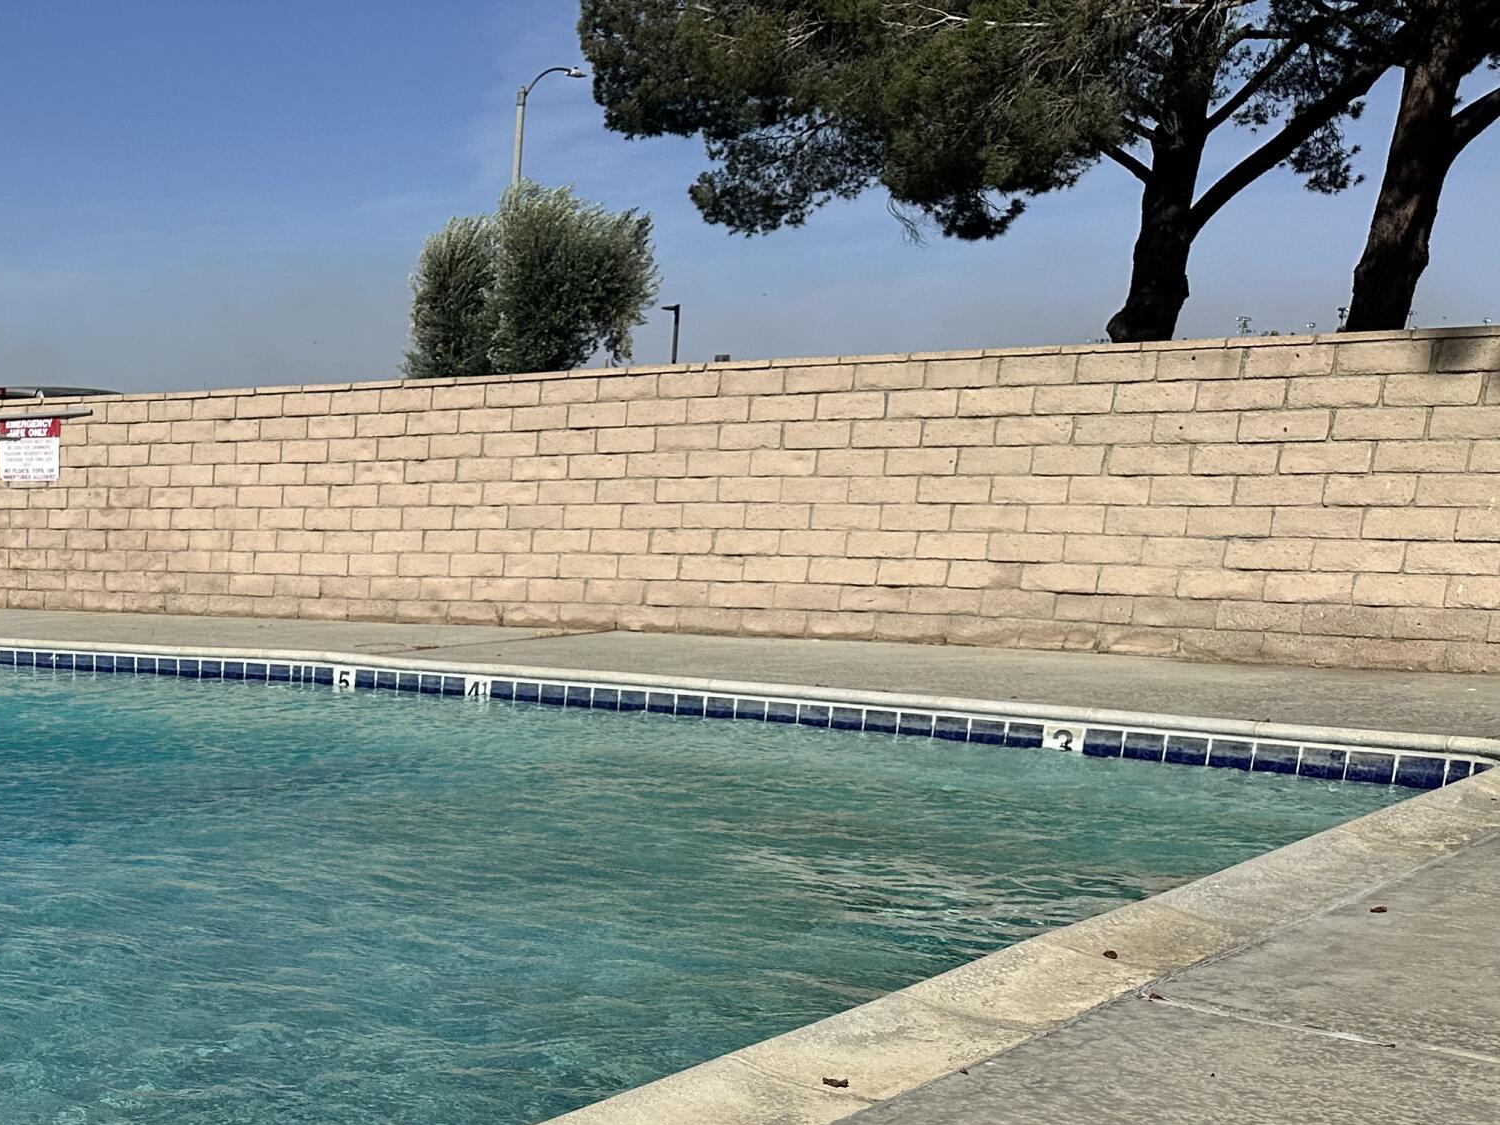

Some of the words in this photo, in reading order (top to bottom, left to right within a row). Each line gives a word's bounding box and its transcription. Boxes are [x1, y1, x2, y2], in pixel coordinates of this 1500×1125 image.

[5, 418, 53, 429] EMERGENCY
[28, 428, 49, 437] ONLY
[338, 670, 350, 687] 5
